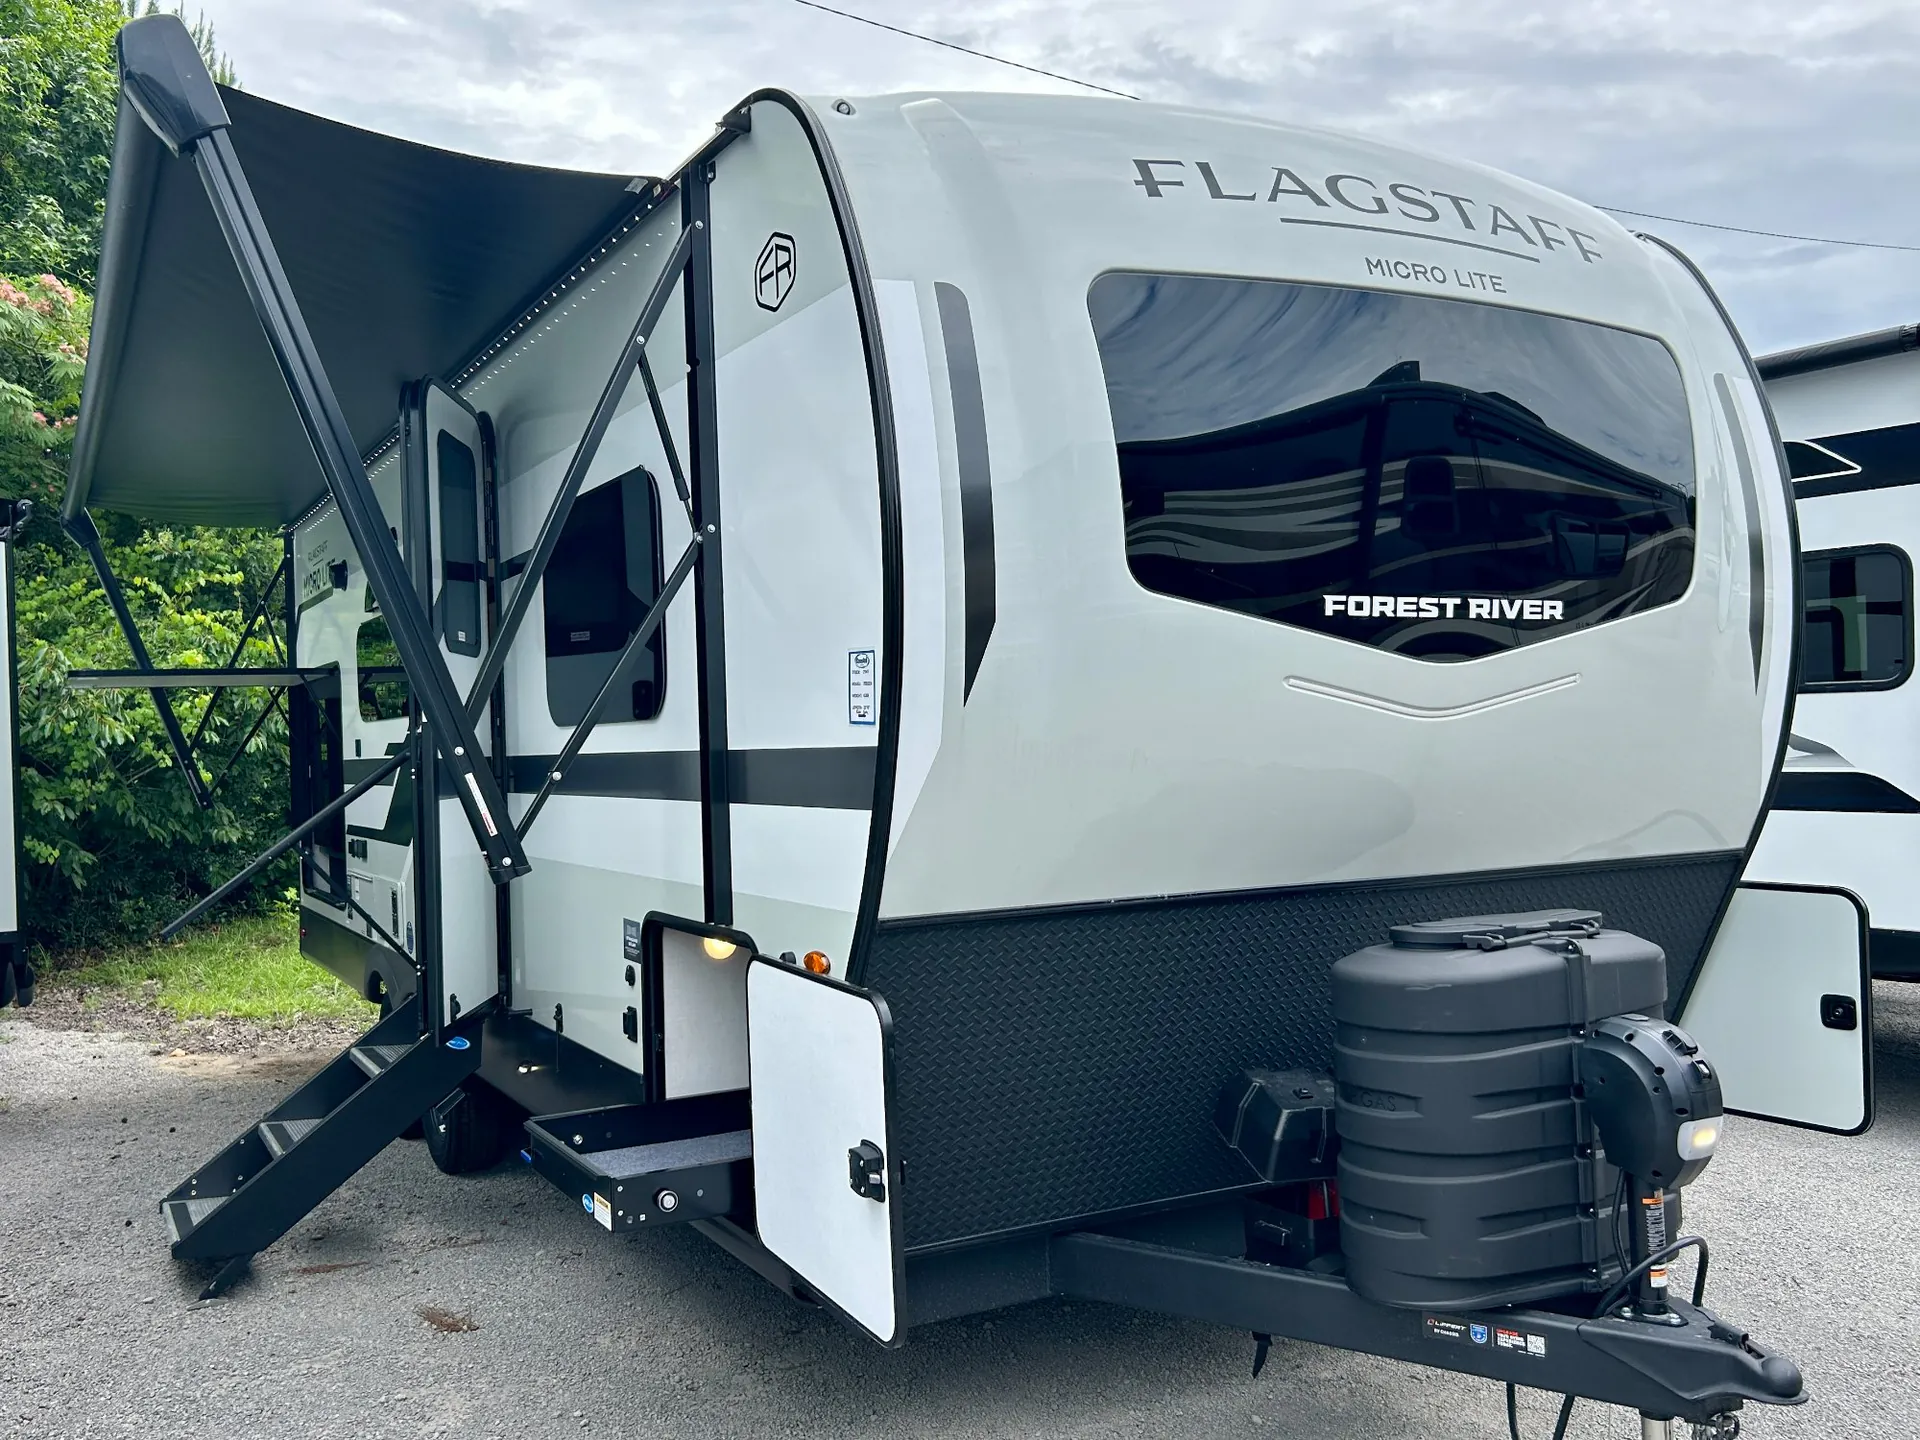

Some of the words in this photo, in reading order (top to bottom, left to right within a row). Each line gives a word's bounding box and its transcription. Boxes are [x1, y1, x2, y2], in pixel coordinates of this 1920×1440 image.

[1132, 158, 1603, 264] FLAGSTAFF
[1364, 257, 1447, 285] MICRO
[1454, 269, 1507, 294] LITE
[1322, 594, 1461, 619] FOREST
[1467, 596, 1565, 620] RIVER
